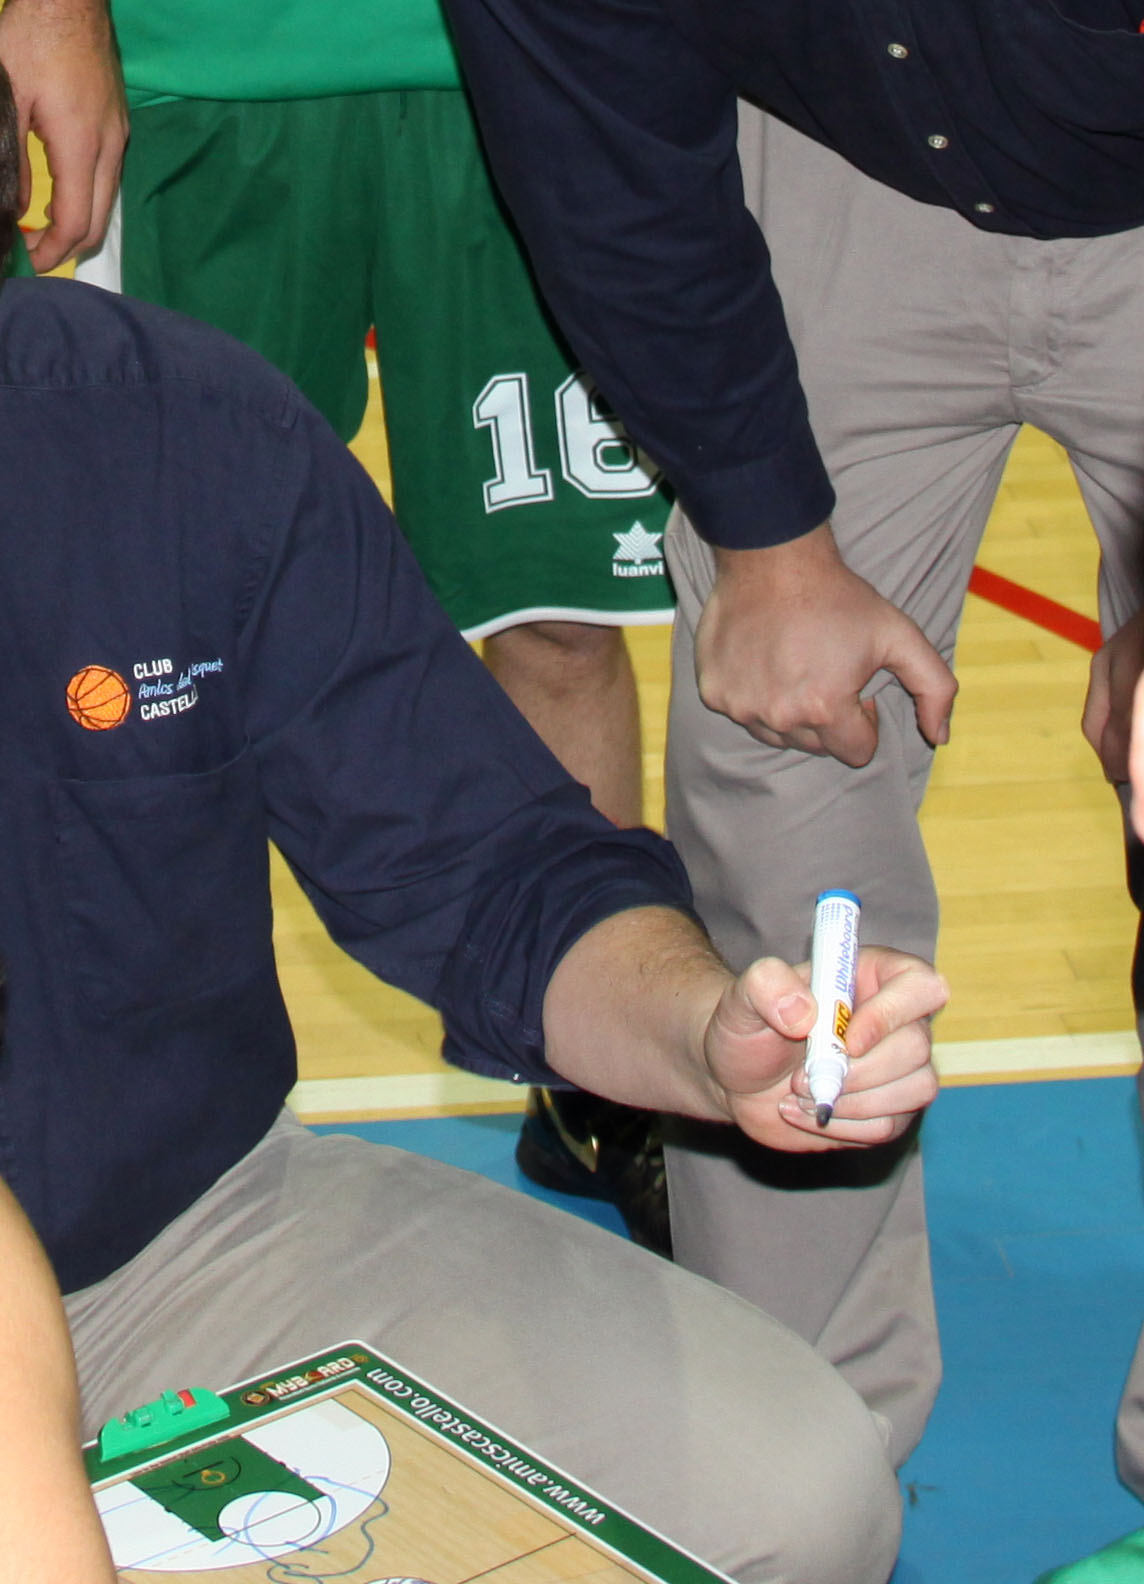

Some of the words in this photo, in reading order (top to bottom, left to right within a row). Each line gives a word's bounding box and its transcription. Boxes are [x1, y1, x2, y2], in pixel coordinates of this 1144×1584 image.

[472, 372, 658, 515] 16
[134, 659, 172, 678] CLUB
[835, 903, 854, 993] Whiteboard
[366, 1367, 606, 1526] www.amicscastello.com
